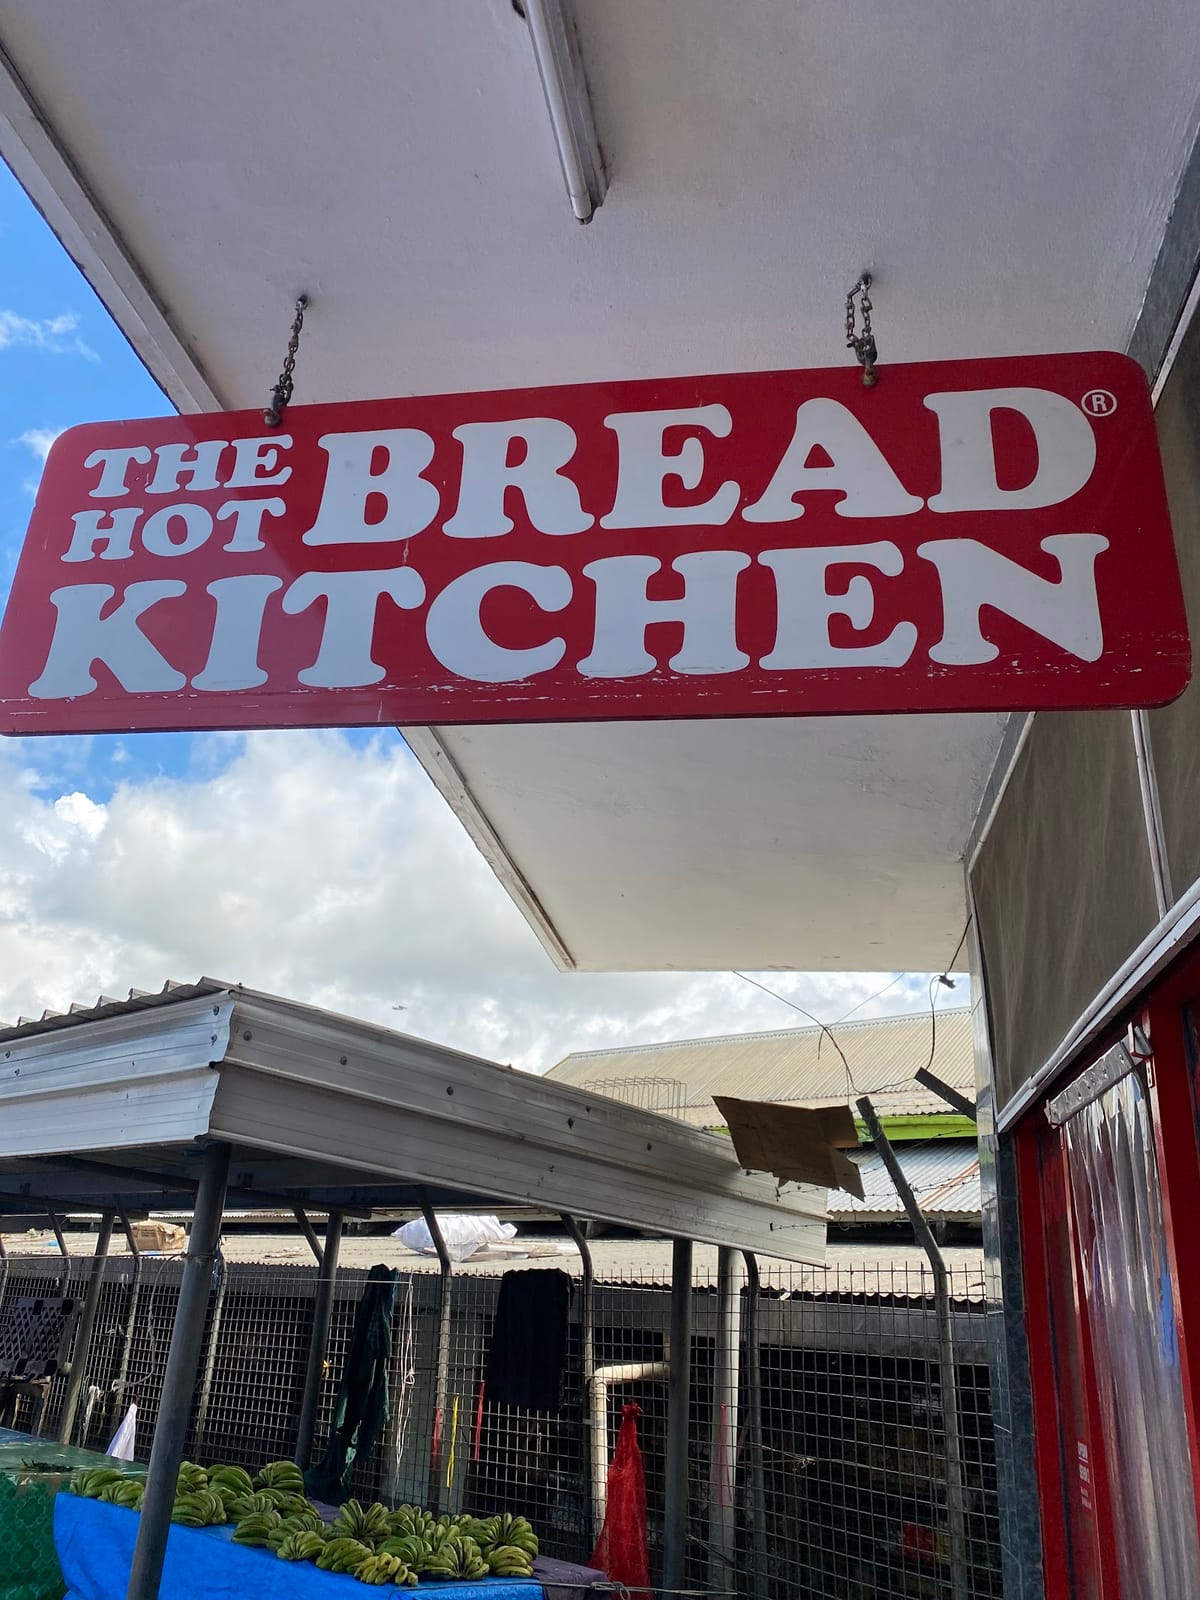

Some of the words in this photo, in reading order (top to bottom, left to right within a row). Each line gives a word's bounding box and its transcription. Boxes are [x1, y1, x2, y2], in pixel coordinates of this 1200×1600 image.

[83, 434, 294, 498] THE
[301, 387, 1097, 547] BREAD
[60, 496, 286, 563] HOT
[27, 533, 1110, 701] KITCHEN
